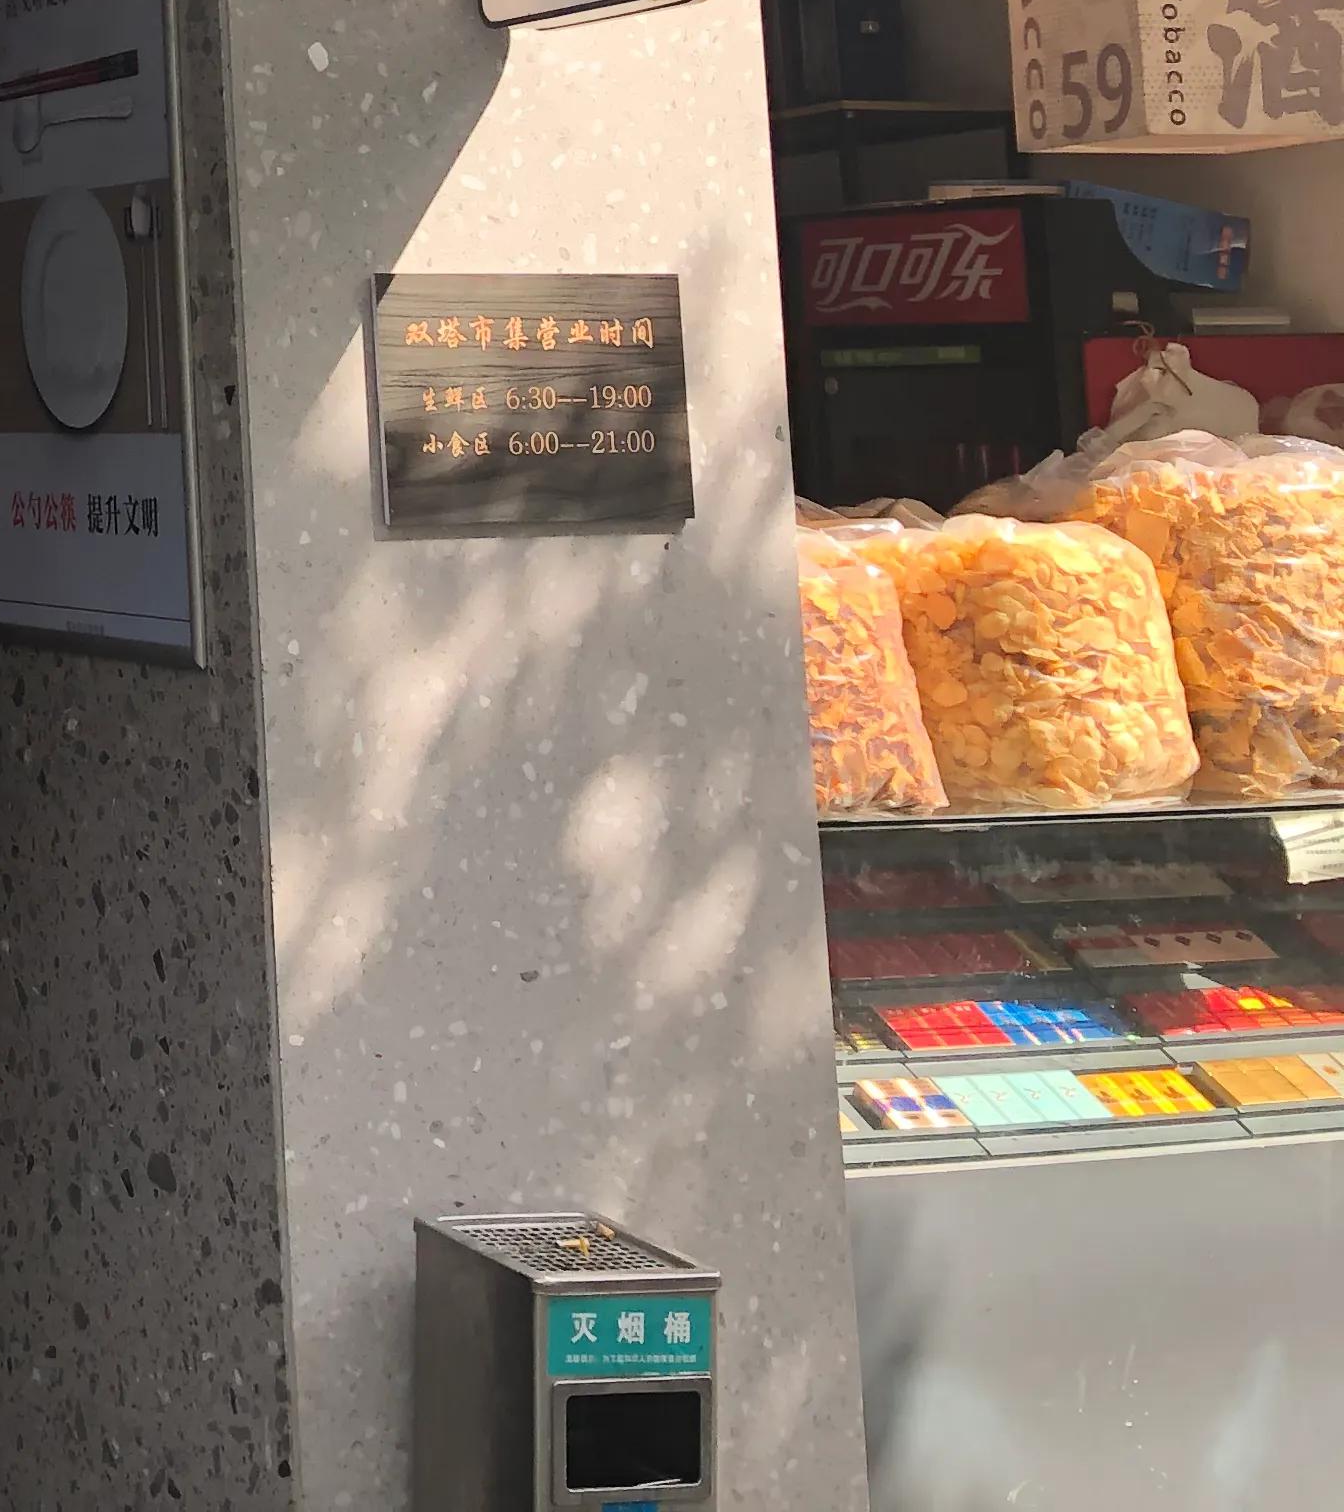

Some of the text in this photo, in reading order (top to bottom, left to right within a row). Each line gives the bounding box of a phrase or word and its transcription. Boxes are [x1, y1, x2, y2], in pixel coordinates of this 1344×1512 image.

[1062, 42, 1133, 139] 59
[812, 223, 1014, 310] 可口可乐
[404, 314, 656, 351] 双塔市集营业时间
[421, 386, 488, 413] 生鲜区
[422, 431, 492, 458] 小食区
[11, 490, 159, 537] 公勺公筷 提升文明
[570, 1312, 692, 1345] 灭烟桶
